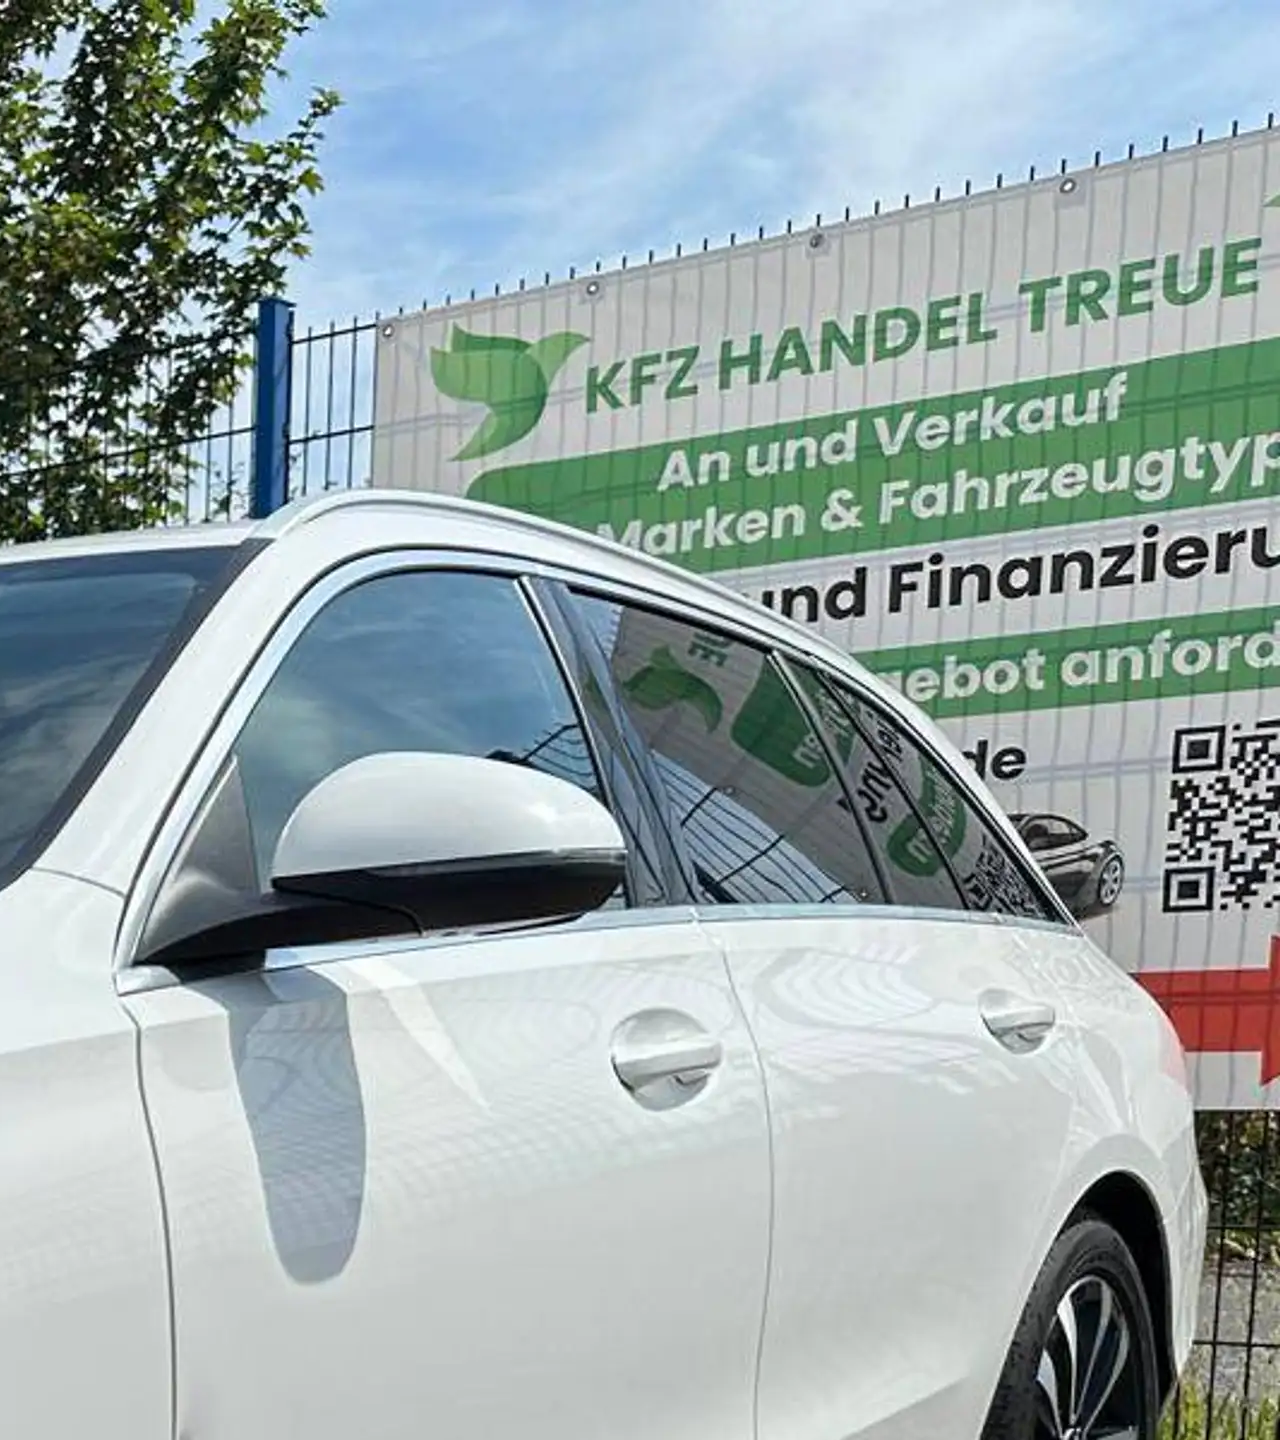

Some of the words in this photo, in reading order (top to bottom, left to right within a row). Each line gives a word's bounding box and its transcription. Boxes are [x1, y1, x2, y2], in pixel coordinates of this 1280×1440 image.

[586, 346, 700, 414] KFZ
[718, 292, 998, 391] HANDEL
[1018, 237, 1262, 332] TREUE
[656, 448, 730, 491] An
[746, 419, 858, 477] und
[873, 371, 1128, 457] Verkauf
[821, 488, 863, 532] &
